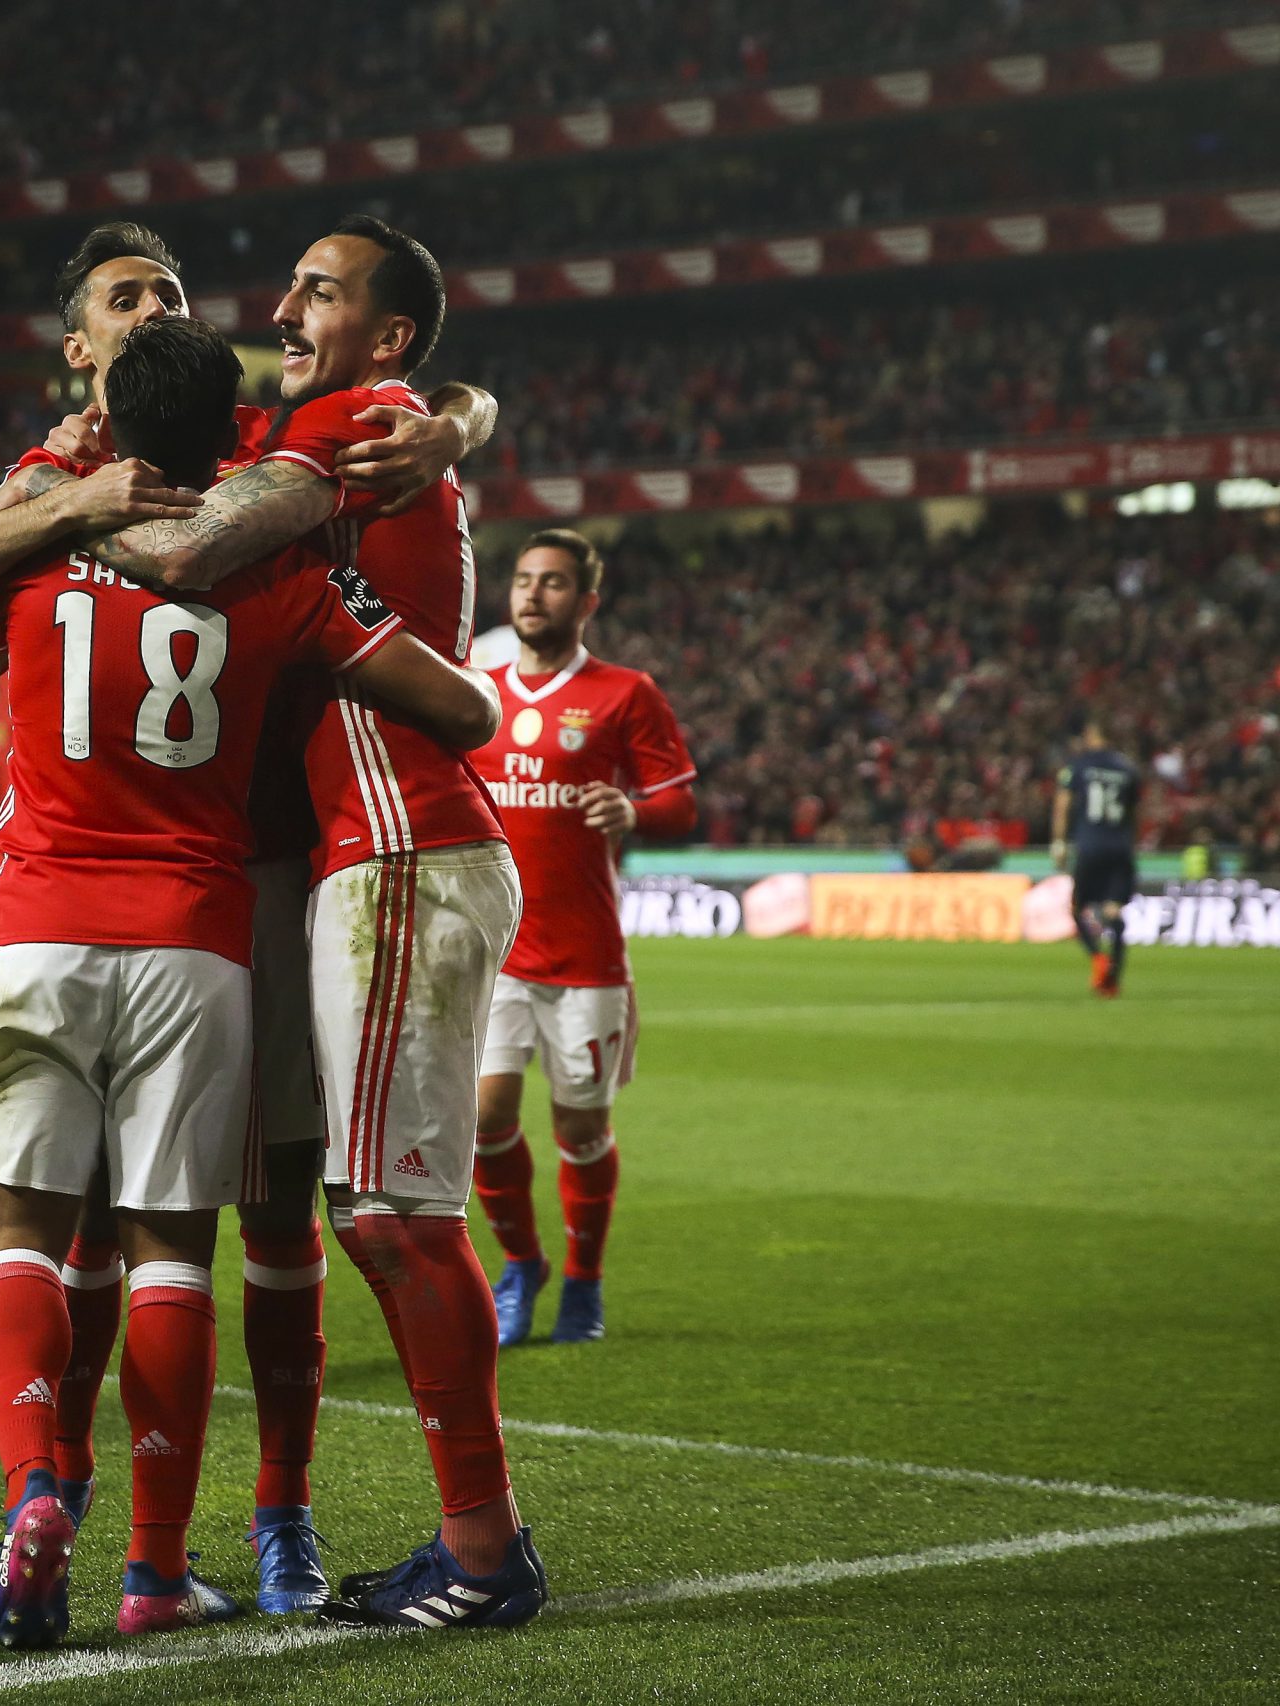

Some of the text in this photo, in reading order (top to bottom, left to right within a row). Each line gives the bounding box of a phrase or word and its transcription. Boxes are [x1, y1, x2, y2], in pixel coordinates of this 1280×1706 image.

[342, 566, 358, 582] LIG
[54, 590, 229, 768] 18
[504, 752, 545, 780] Fly
[393, 1162, 430, 1178] adidas
